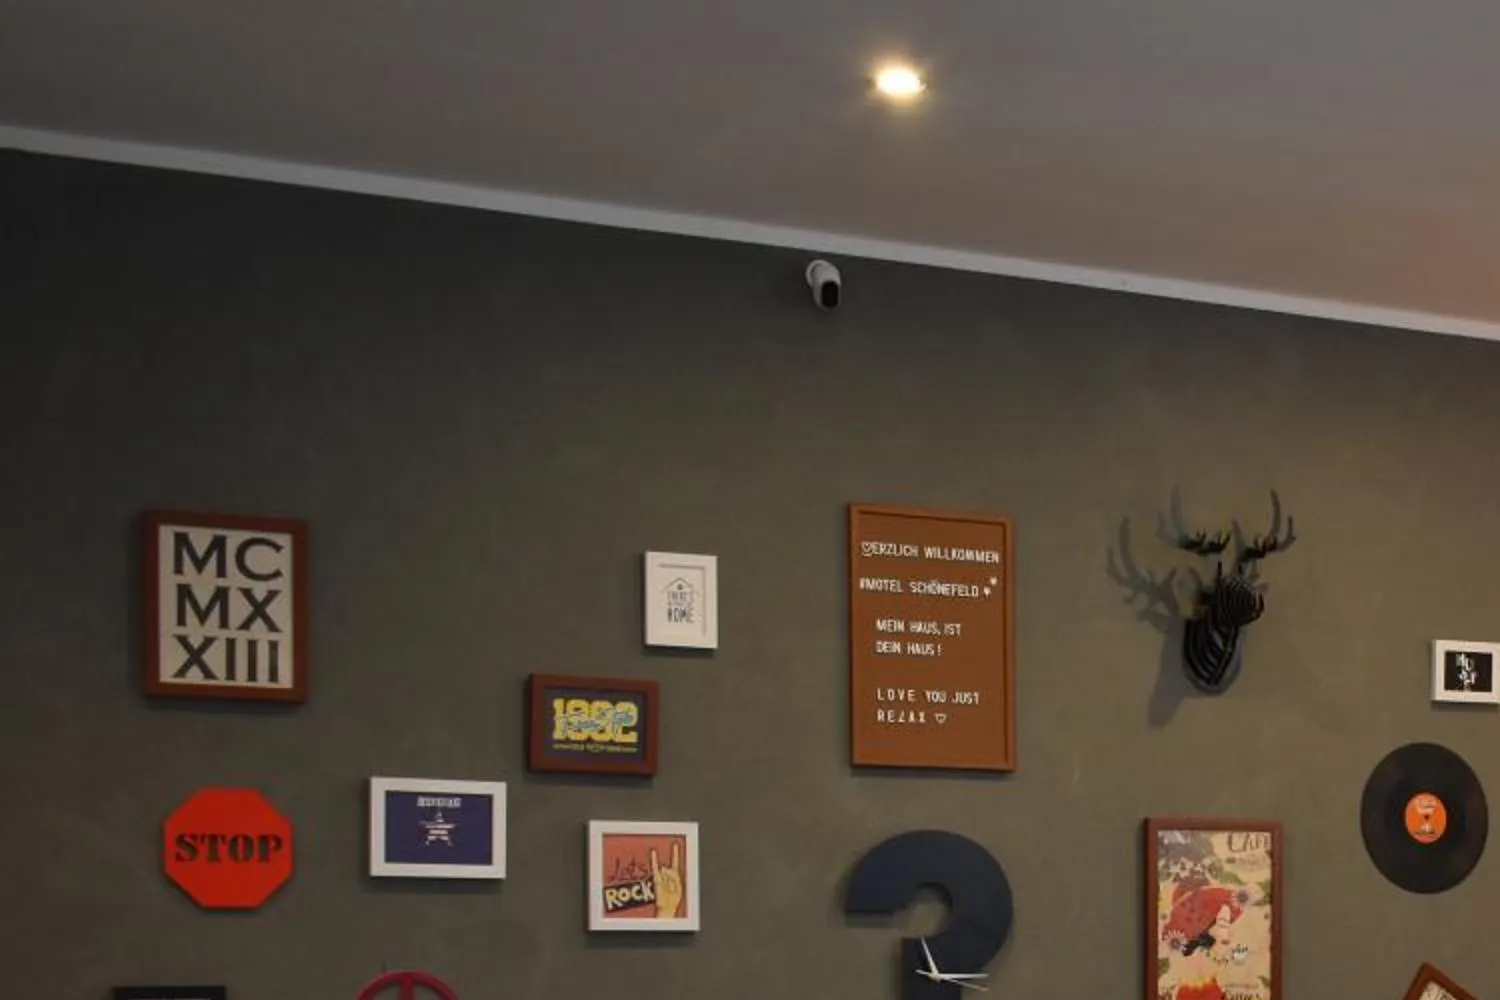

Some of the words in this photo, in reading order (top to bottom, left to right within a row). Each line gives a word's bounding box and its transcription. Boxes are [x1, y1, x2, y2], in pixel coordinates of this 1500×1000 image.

[173, 532, 284, 581] MC
[924, 545, 999, 564] WILLKOMMEN
[176, 584, 283, 633] MX
[876, 619, 905, 633] MEIN
[171, 634, 279, 683] XIII
[876, 641, 901, 654] DEIN
[877, 688, 917, 702] LOVE
[924, 690, 947, 703] YOU
[951, 691, 980, 705] JUST
[877, 709, 926, 723] RELAX
[175, 833, 284, 863] STOP
[606, 880, 655, 910] ROCK
